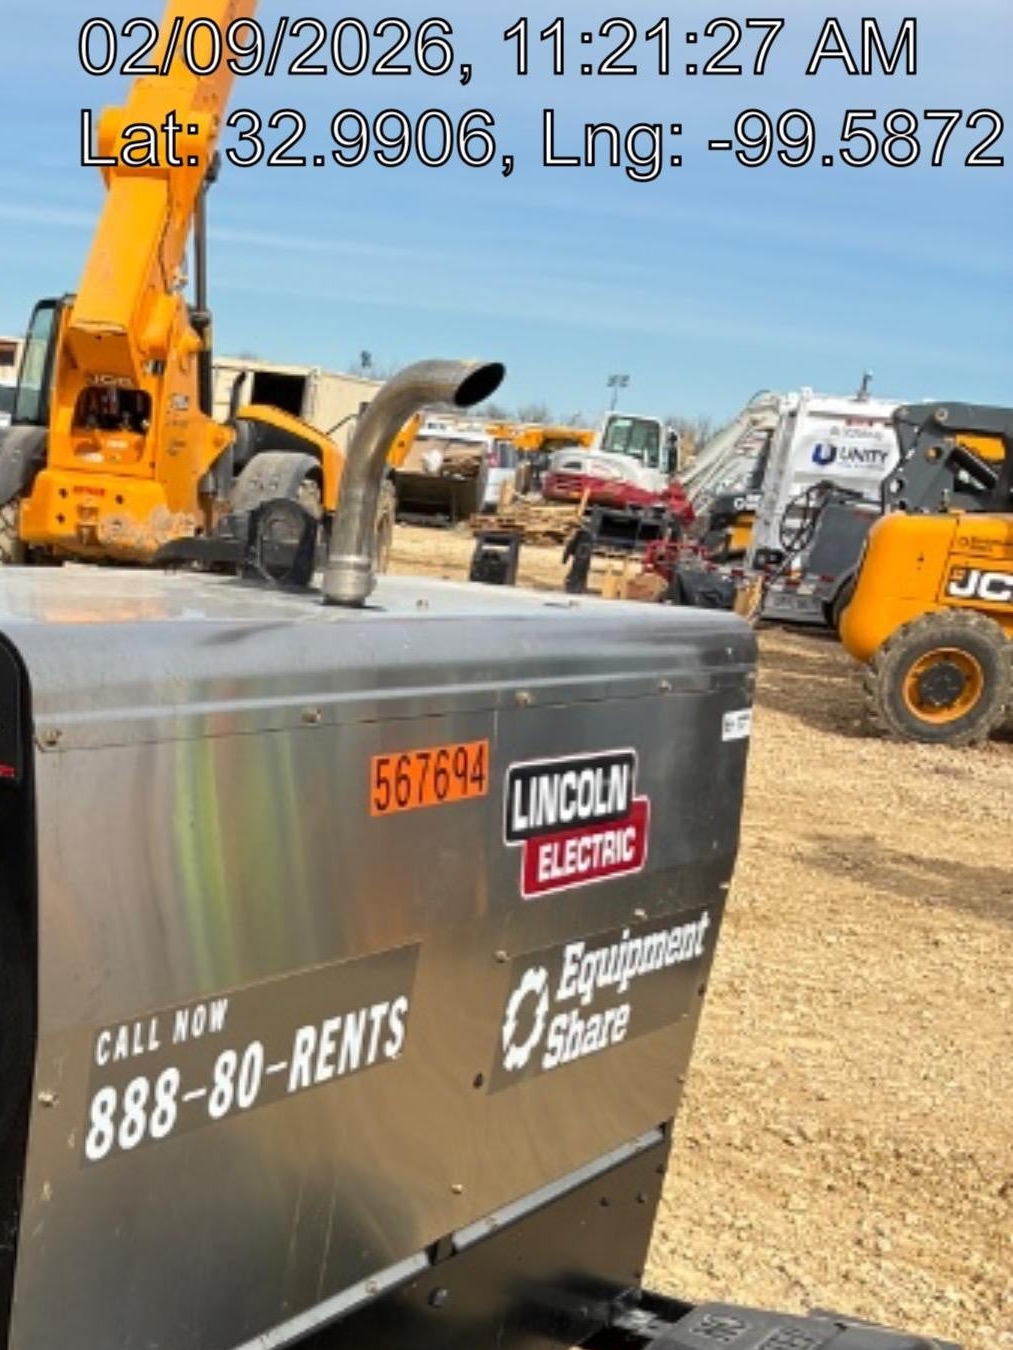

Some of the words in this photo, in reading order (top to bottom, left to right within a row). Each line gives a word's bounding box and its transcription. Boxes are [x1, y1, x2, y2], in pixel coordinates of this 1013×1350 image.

[839, 446, 888, 463] UNITY
[372, 746, 486, 811] 567694
[512, 764, 629, 832] LINCOLN
[537, 826, 637, 883] ELECTRIC
[555, 910, 710, 1006] Equipment
[96, 1018, 160, 1066] CALL
[173, 998, 228, 1044] NOW
[542, 1003, 631, 1069] Share
[85, 995, 408, 1161] 888-80-RENTS
